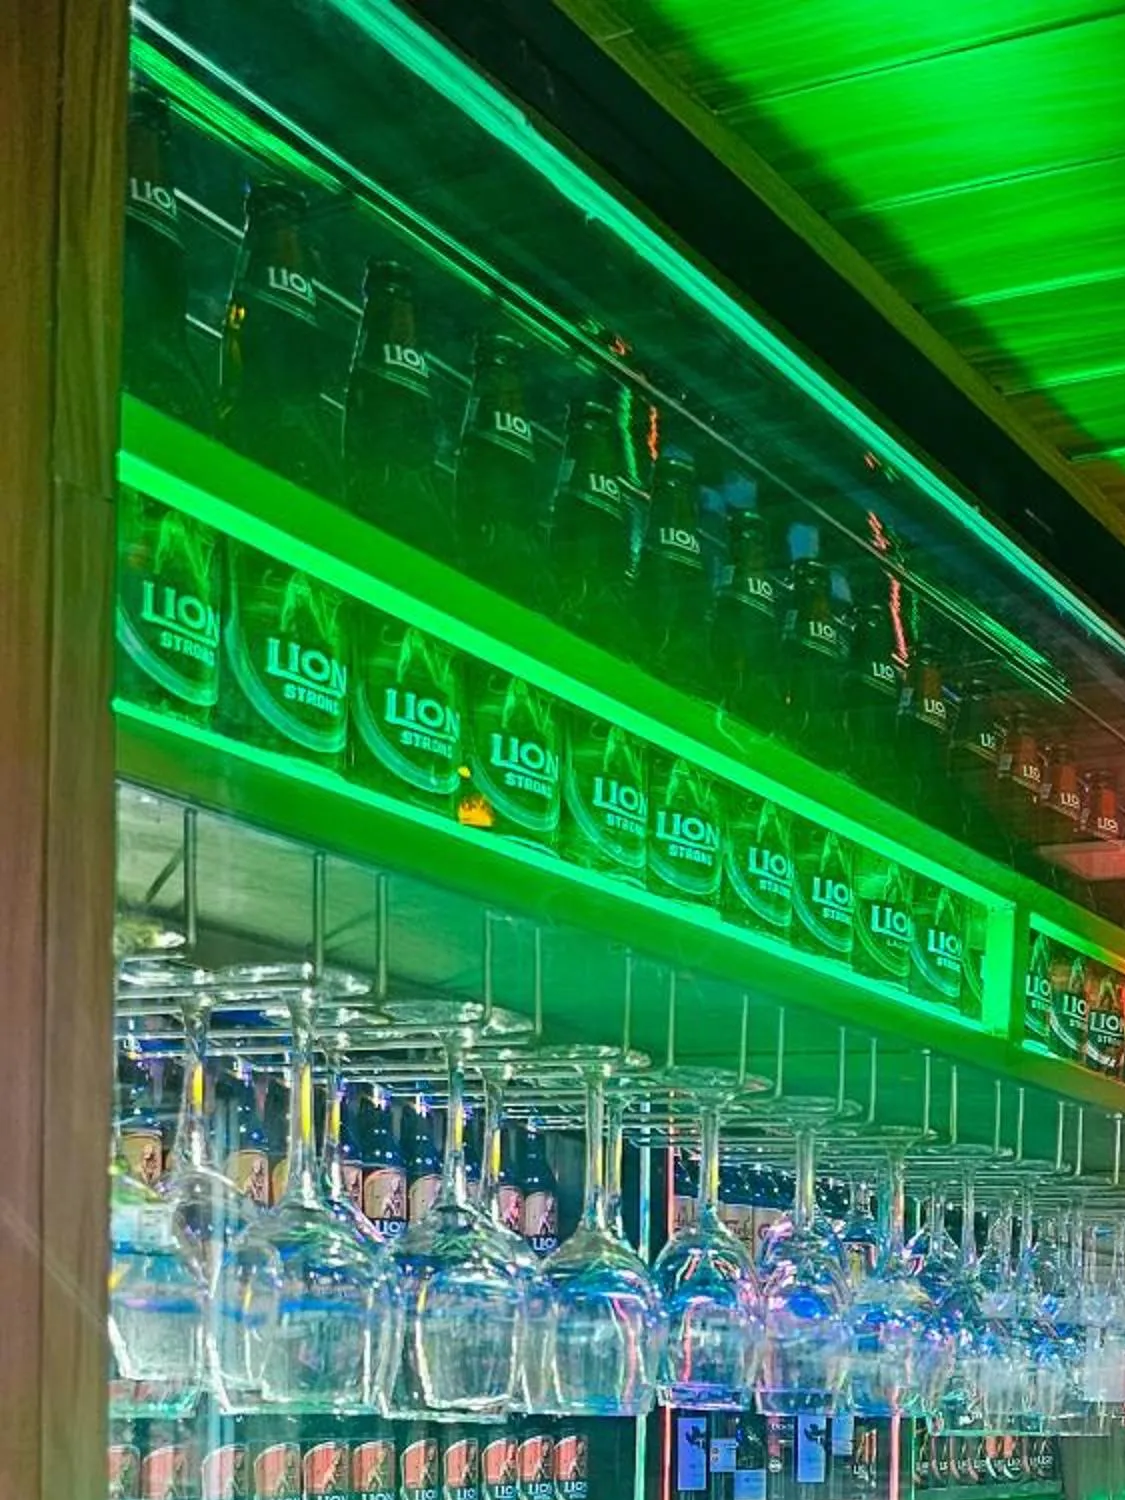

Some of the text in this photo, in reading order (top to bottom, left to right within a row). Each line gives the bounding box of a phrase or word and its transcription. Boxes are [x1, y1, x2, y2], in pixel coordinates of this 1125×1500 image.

[590, 474, 619, 497] LIO
[748, 577, 773, 597] LIO
[141, 580, 220, 648] LION
[810, 621, 837, 639] LIO
[265, 637, 347, 698] LION
[873, 662, 896, 679] LIO
[385, 688, 460, 743] LION
[490, 733, 559, 783] LION
[656, 811, 721, 852] LION
[812, 876, 855, 912] LIO
[928, 928, 963, 961] LIO
[1026, 975, 1050, 1004] LIO
[1063, 993, 1087, 1020] LIO
[457, 1488, 477, 1500] LIO
[495, 1486, 514, 1499] LIO
